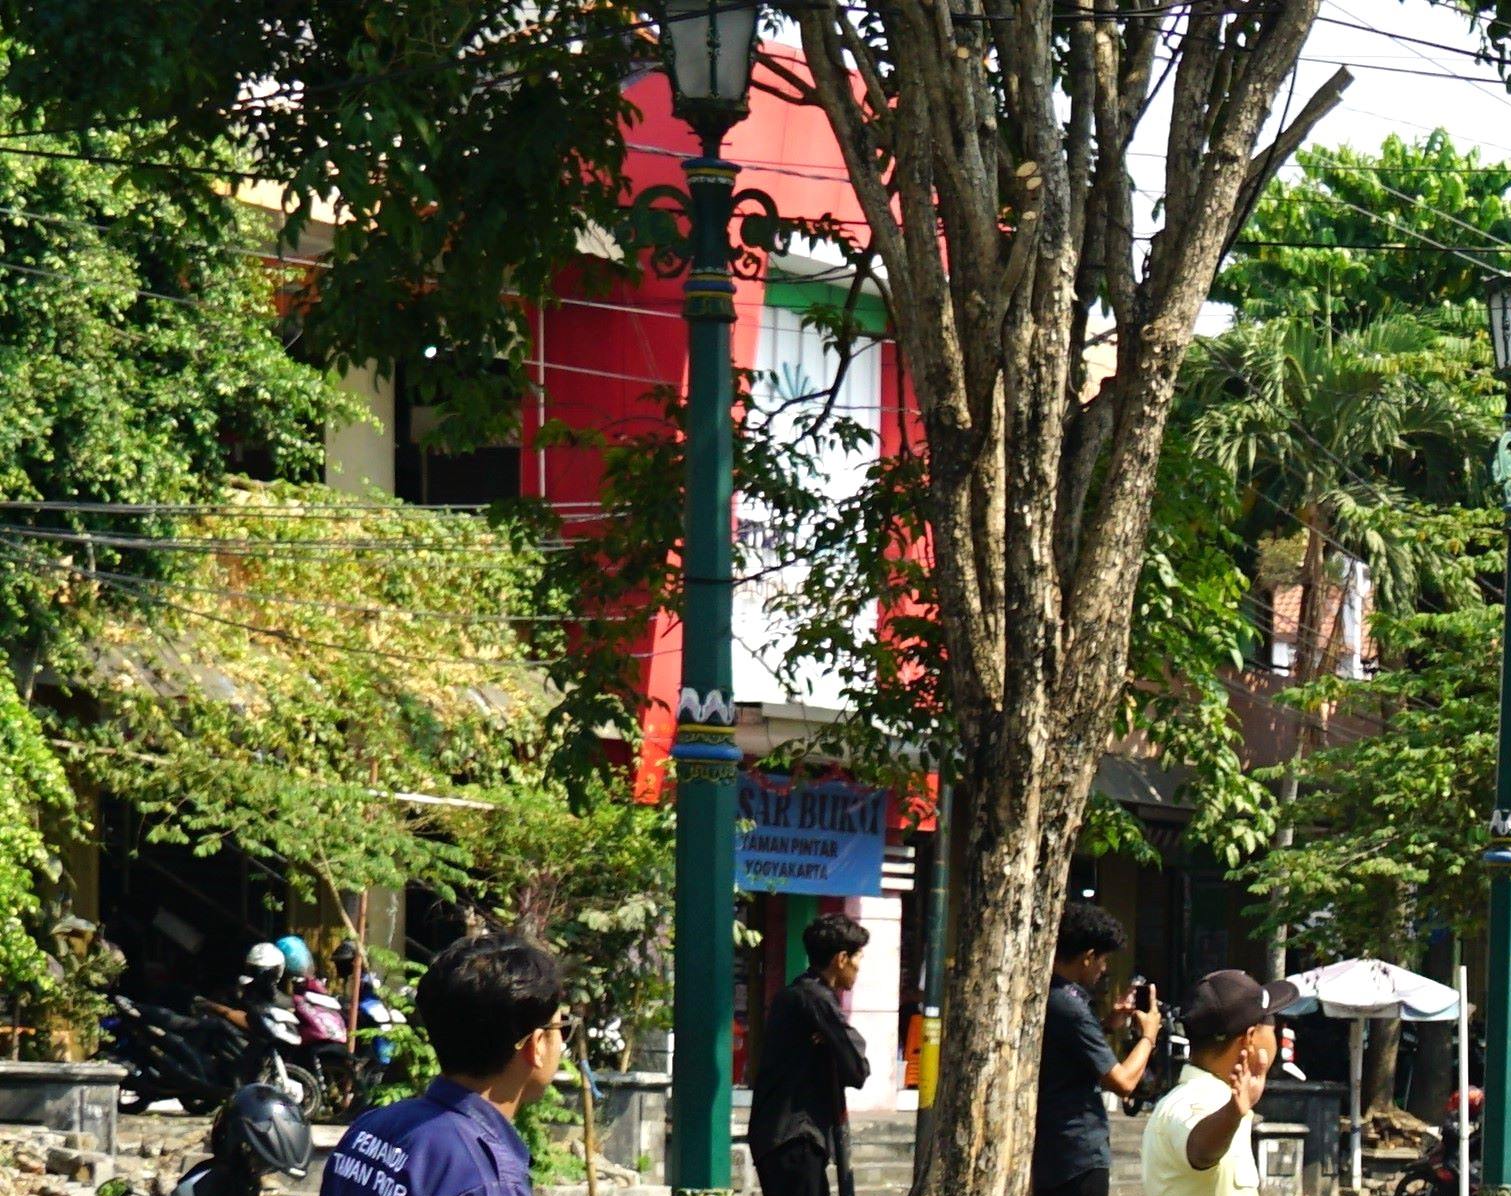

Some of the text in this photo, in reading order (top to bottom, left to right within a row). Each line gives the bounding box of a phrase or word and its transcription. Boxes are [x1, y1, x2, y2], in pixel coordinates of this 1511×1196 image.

[738, 787, 792, 829] SAR
[742, 834, 839, 858] TAMAN PINTAR
[745, 860, 828, 880] YOGYAKARTA
[333, 1152, 374, 1186] TAMAN
[352, 1131, 409, 1173] PEMANDU
